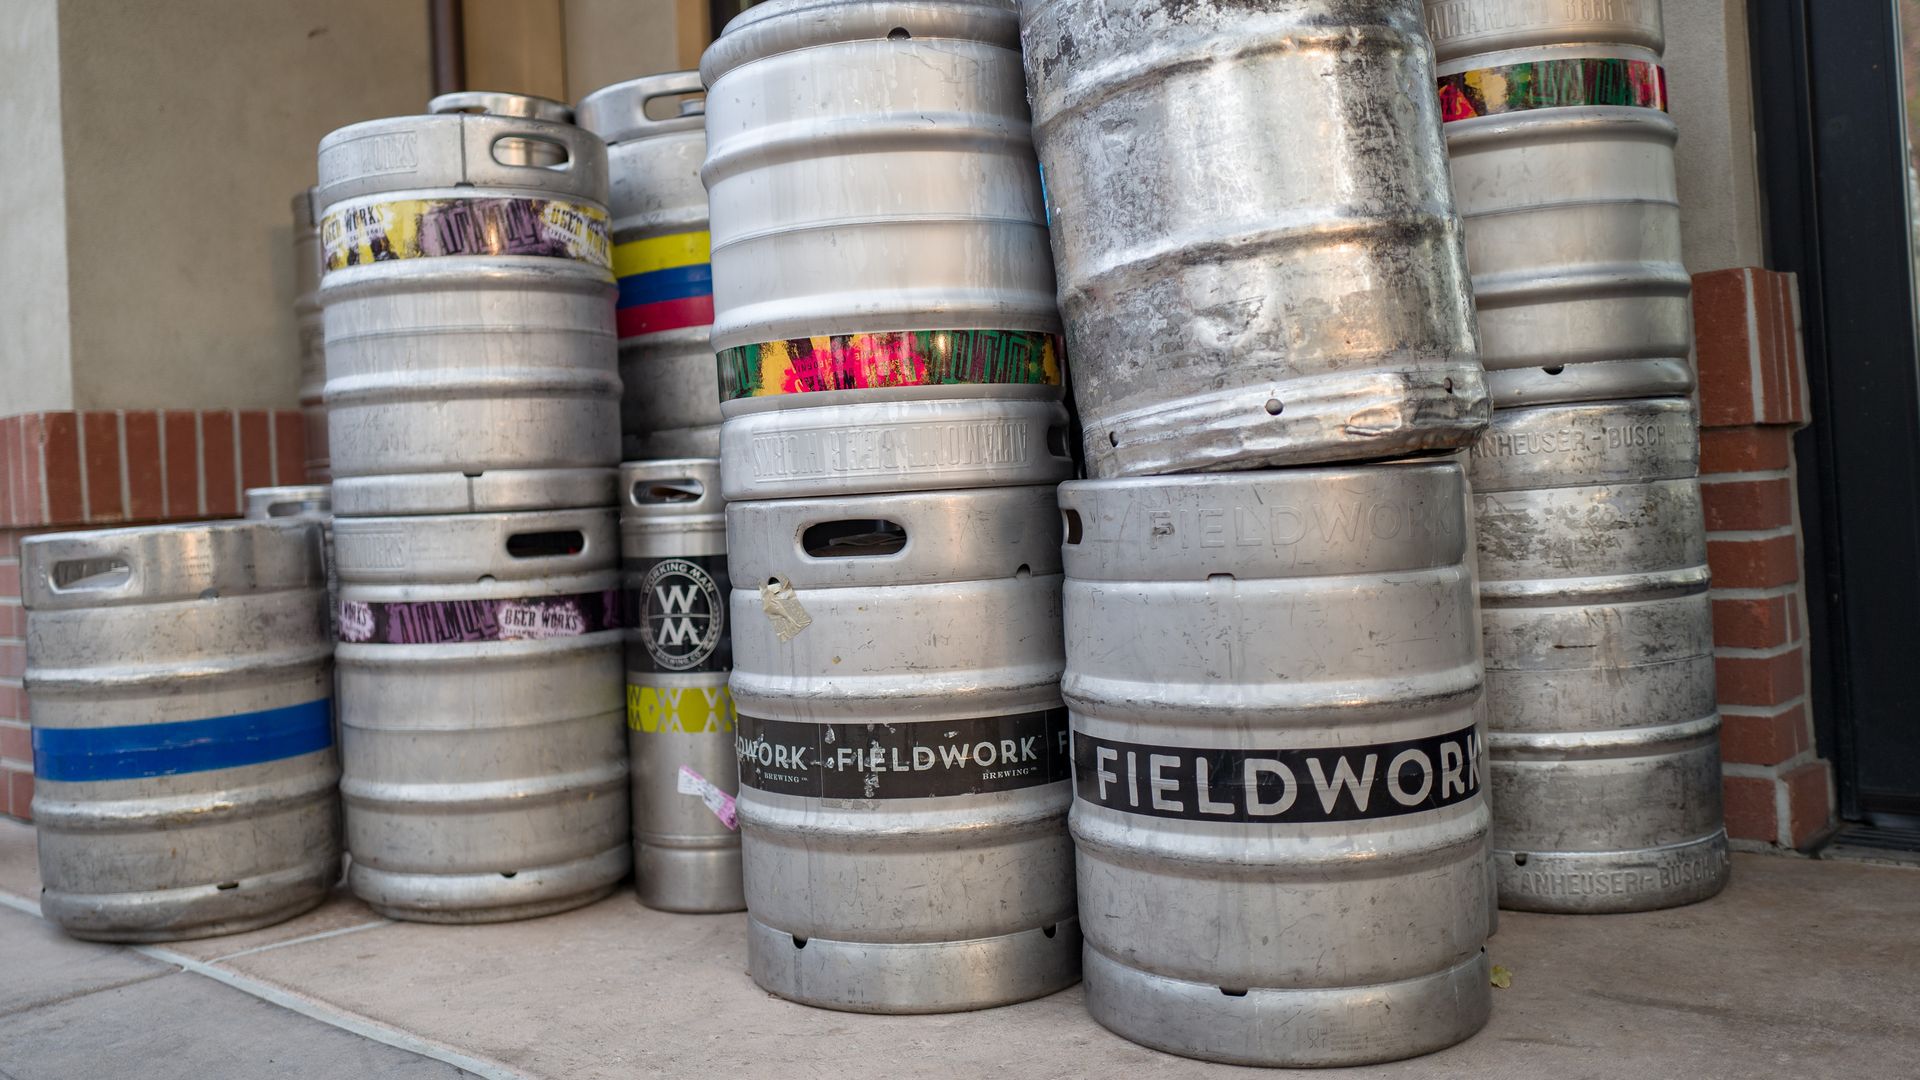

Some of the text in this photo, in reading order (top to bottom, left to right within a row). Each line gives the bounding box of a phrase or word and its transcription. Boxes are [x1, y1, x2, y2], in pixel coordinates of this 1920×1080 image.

[753, 422, 1028, 478] ALTAMONT BEER WORKS
[1149, 497, 1454, 551] FIELDWORK
[643, 562, 714, 594] WORKING MAN
[504, 608, 578, 631] BEER WORKS
[737, 734, 808, 771] DWORK
[837, 735, 1038, 772] FIELDWORK
[764, 771, 799, 783] BREWING
[982, 767, 1030, 781] BREWING
[1097, 729, 1482, 817] FIELDWORK
